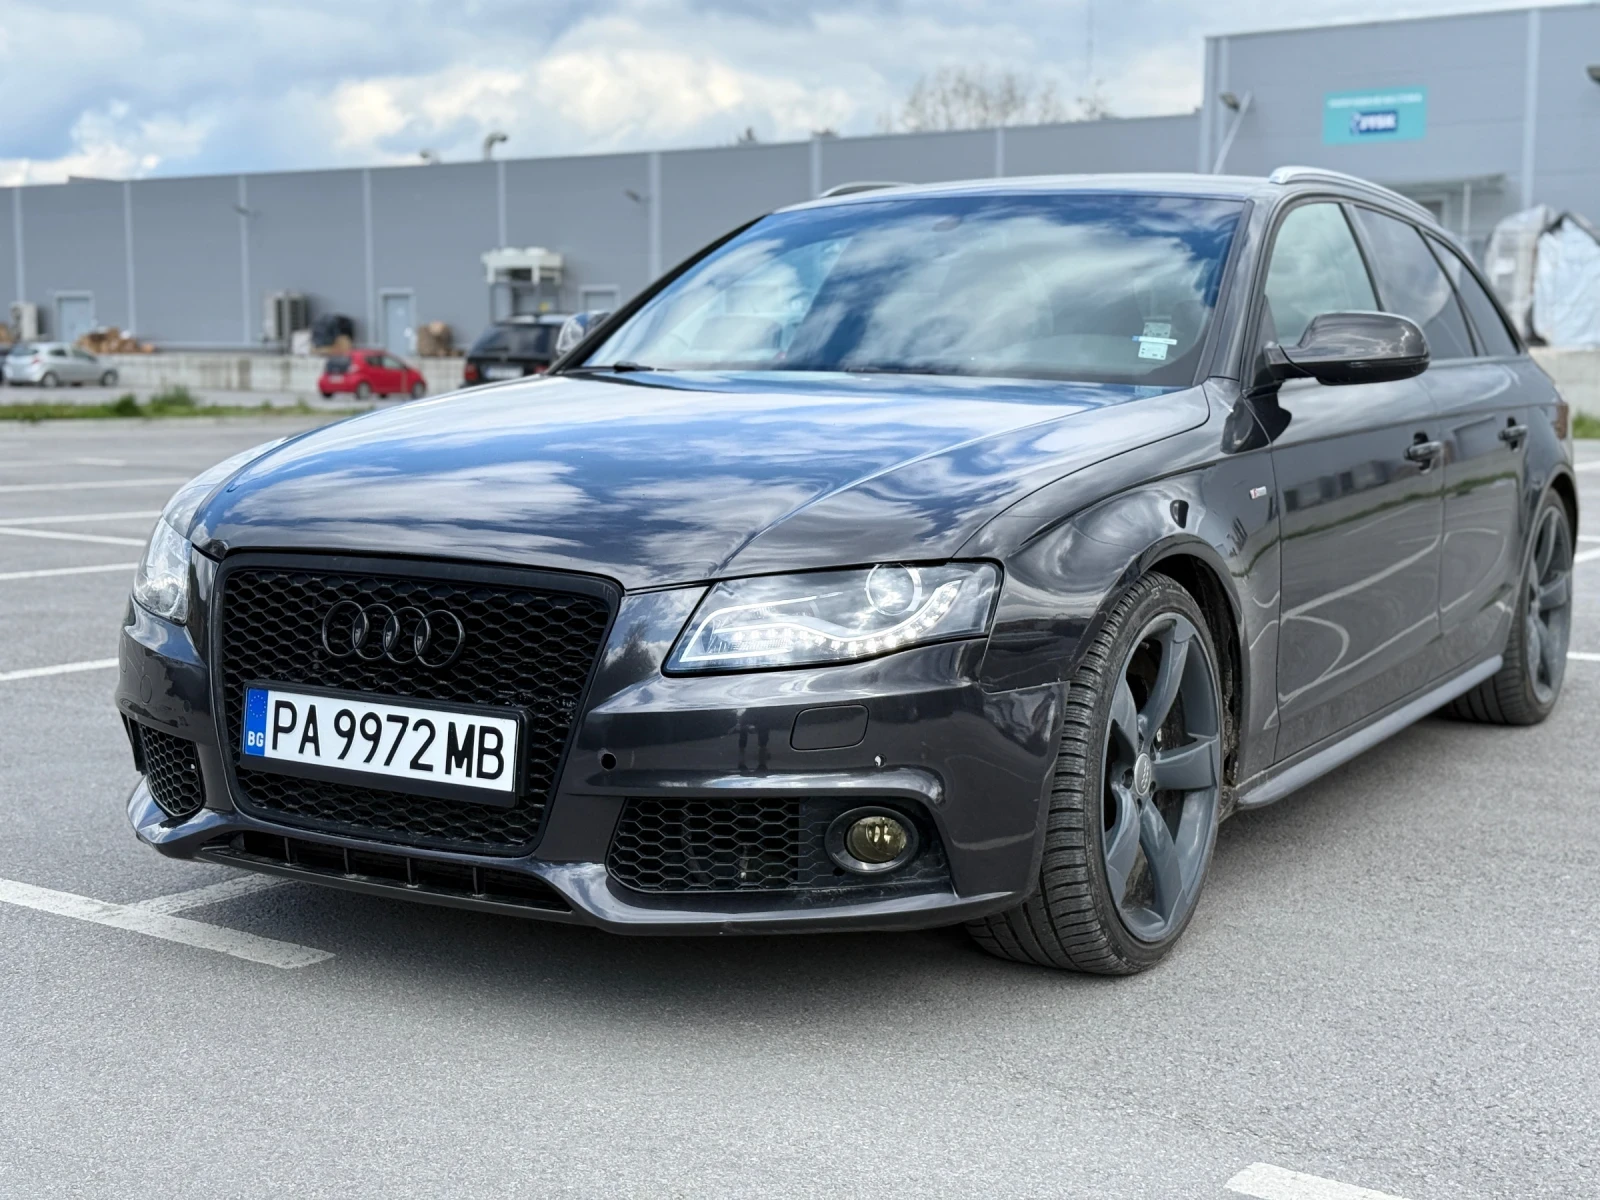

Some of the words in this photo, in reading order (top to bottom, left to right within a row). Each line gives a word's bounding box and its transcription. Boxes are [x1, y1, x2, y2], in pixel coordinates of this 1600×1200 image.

[247, 730, 264, 747] BG
[272, 700, 321, 757] PA
[333, 709, 436, 772] 9972
[445, 721, 505, 780] MB
